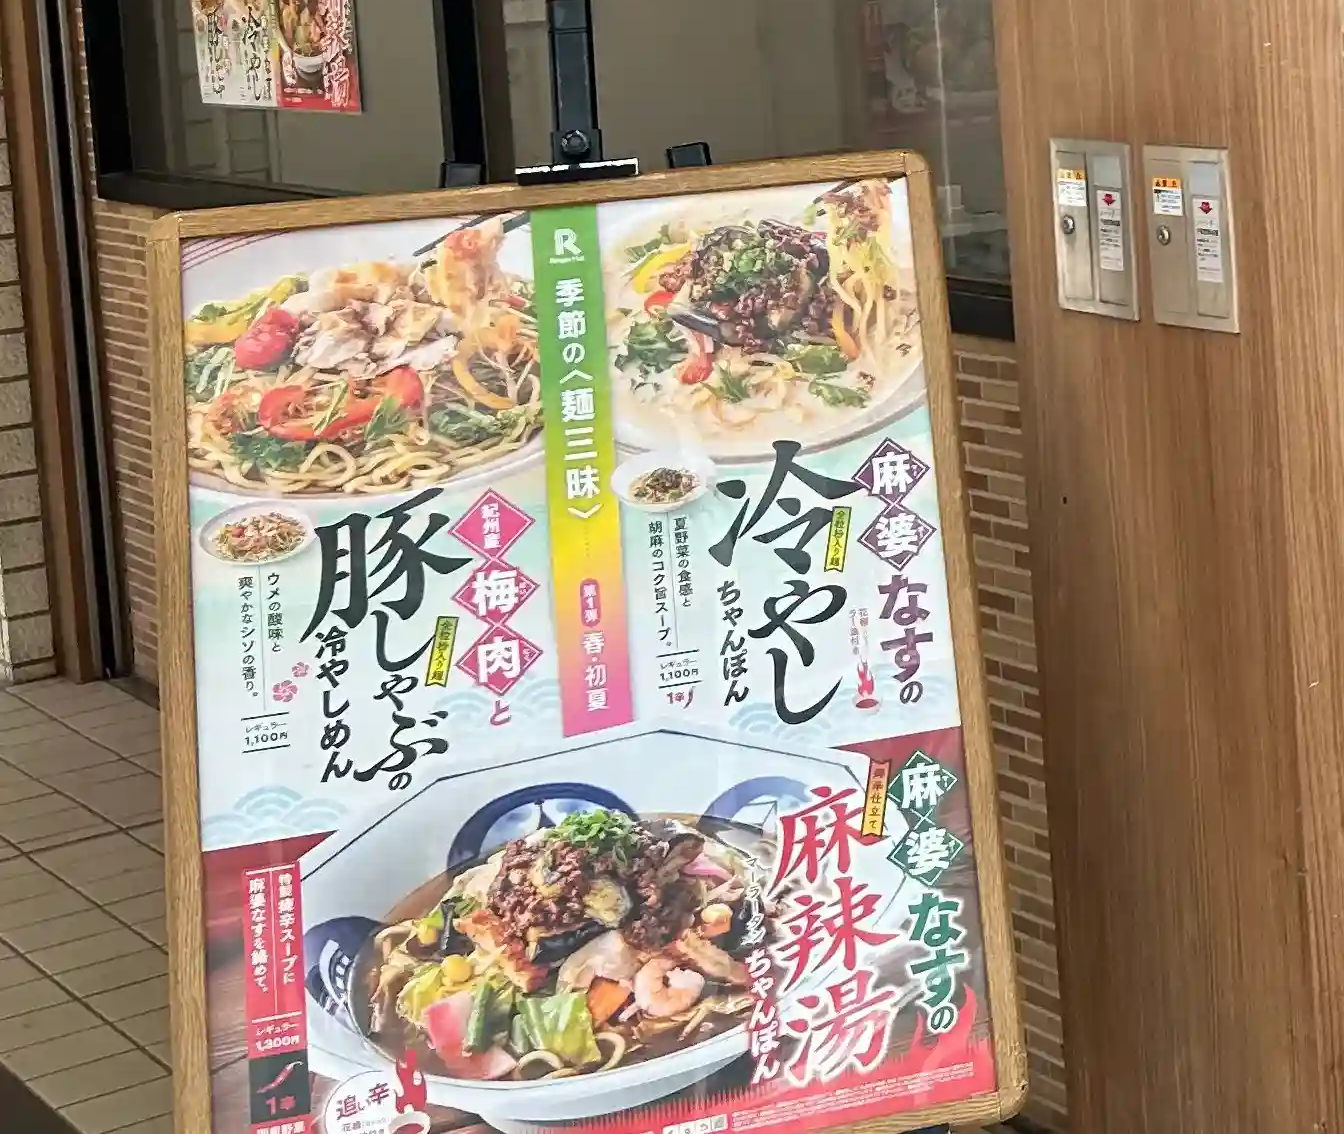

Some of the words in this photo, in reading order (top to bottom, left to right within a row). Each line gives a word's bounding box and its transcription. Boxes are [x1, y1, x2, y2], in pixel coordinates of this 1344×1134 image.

[554, 227, 583, 256] R
[267, 571, 284, 653] ウメの酸味と
[673, 516, 694, 608] 夏野菜の食感と
[707, 439, 865, 726] 冷やし
[870, 451, 934, 705] 麻婆なすの
[237, 575, 259, 698] 爽やかなシソの香り。
[299, 487, 474, 791] 豚しゃぶの
[314, 625, 354, 784] 冷やしめん
[471, 570, 522, 726] 梅肉と
[659, 667, 700, 682] 1,100円
[716, 579, 750, 707] ちゃんぽん
[244, 731, 288, 747] 1,100円
[768, 784, 901, 1080] 麻辣湯
[901, 762, 967, 1032] 麻婆なすの
[745, 947, 781, 1085] ちゃんぽん
